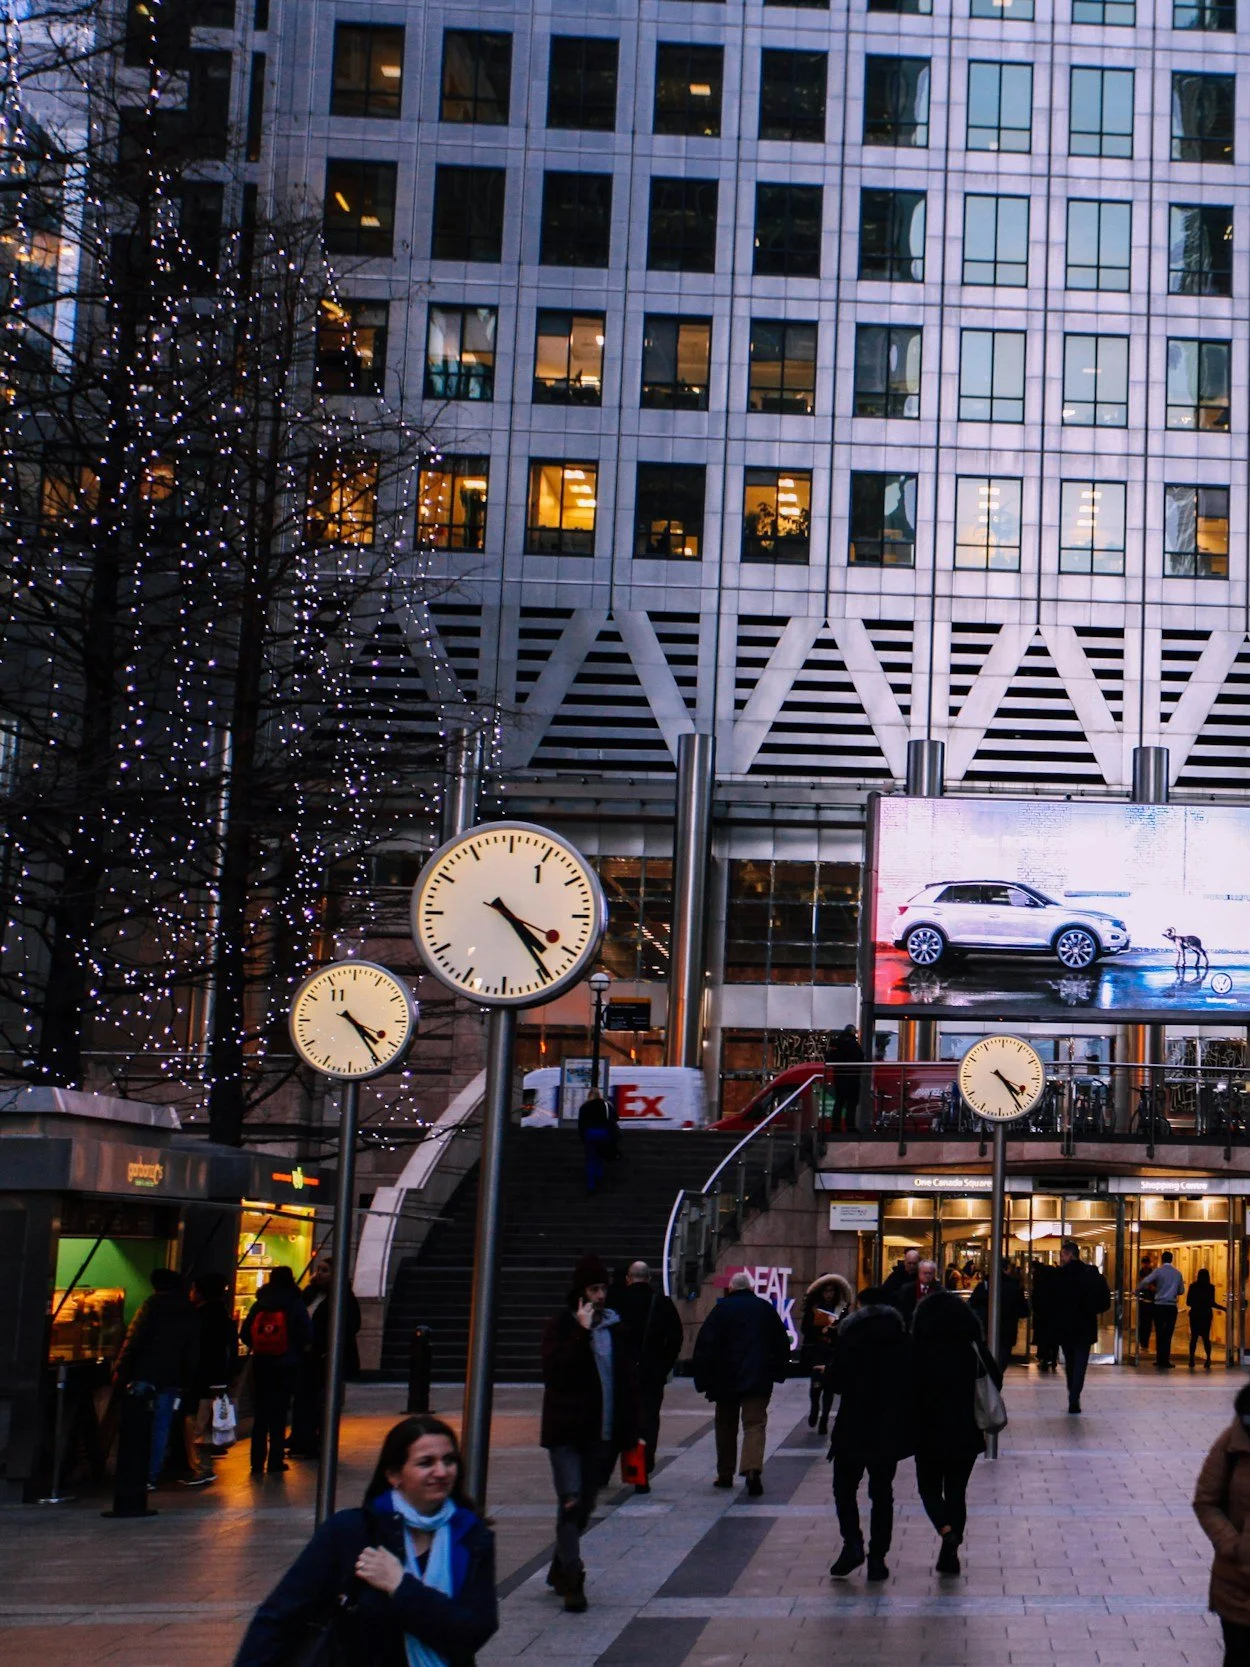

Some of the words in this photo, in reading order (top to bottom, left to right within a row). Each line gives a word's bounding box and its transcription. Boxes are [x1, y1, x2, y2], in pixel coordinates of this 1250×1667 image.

[533, 864, 541, 884] 1
[331, 989, 344, 1002] 11
[914, 1178, 932, 1188] One
[932, 1178, 963, 1188] Canada
[963, 1178, 992, 1190] Square
[1140, 1180, 1180, 1192] Shopping
[1180, 1181, 1208, 1190] Centre
[754, 1266, 793, 1299] EAT
